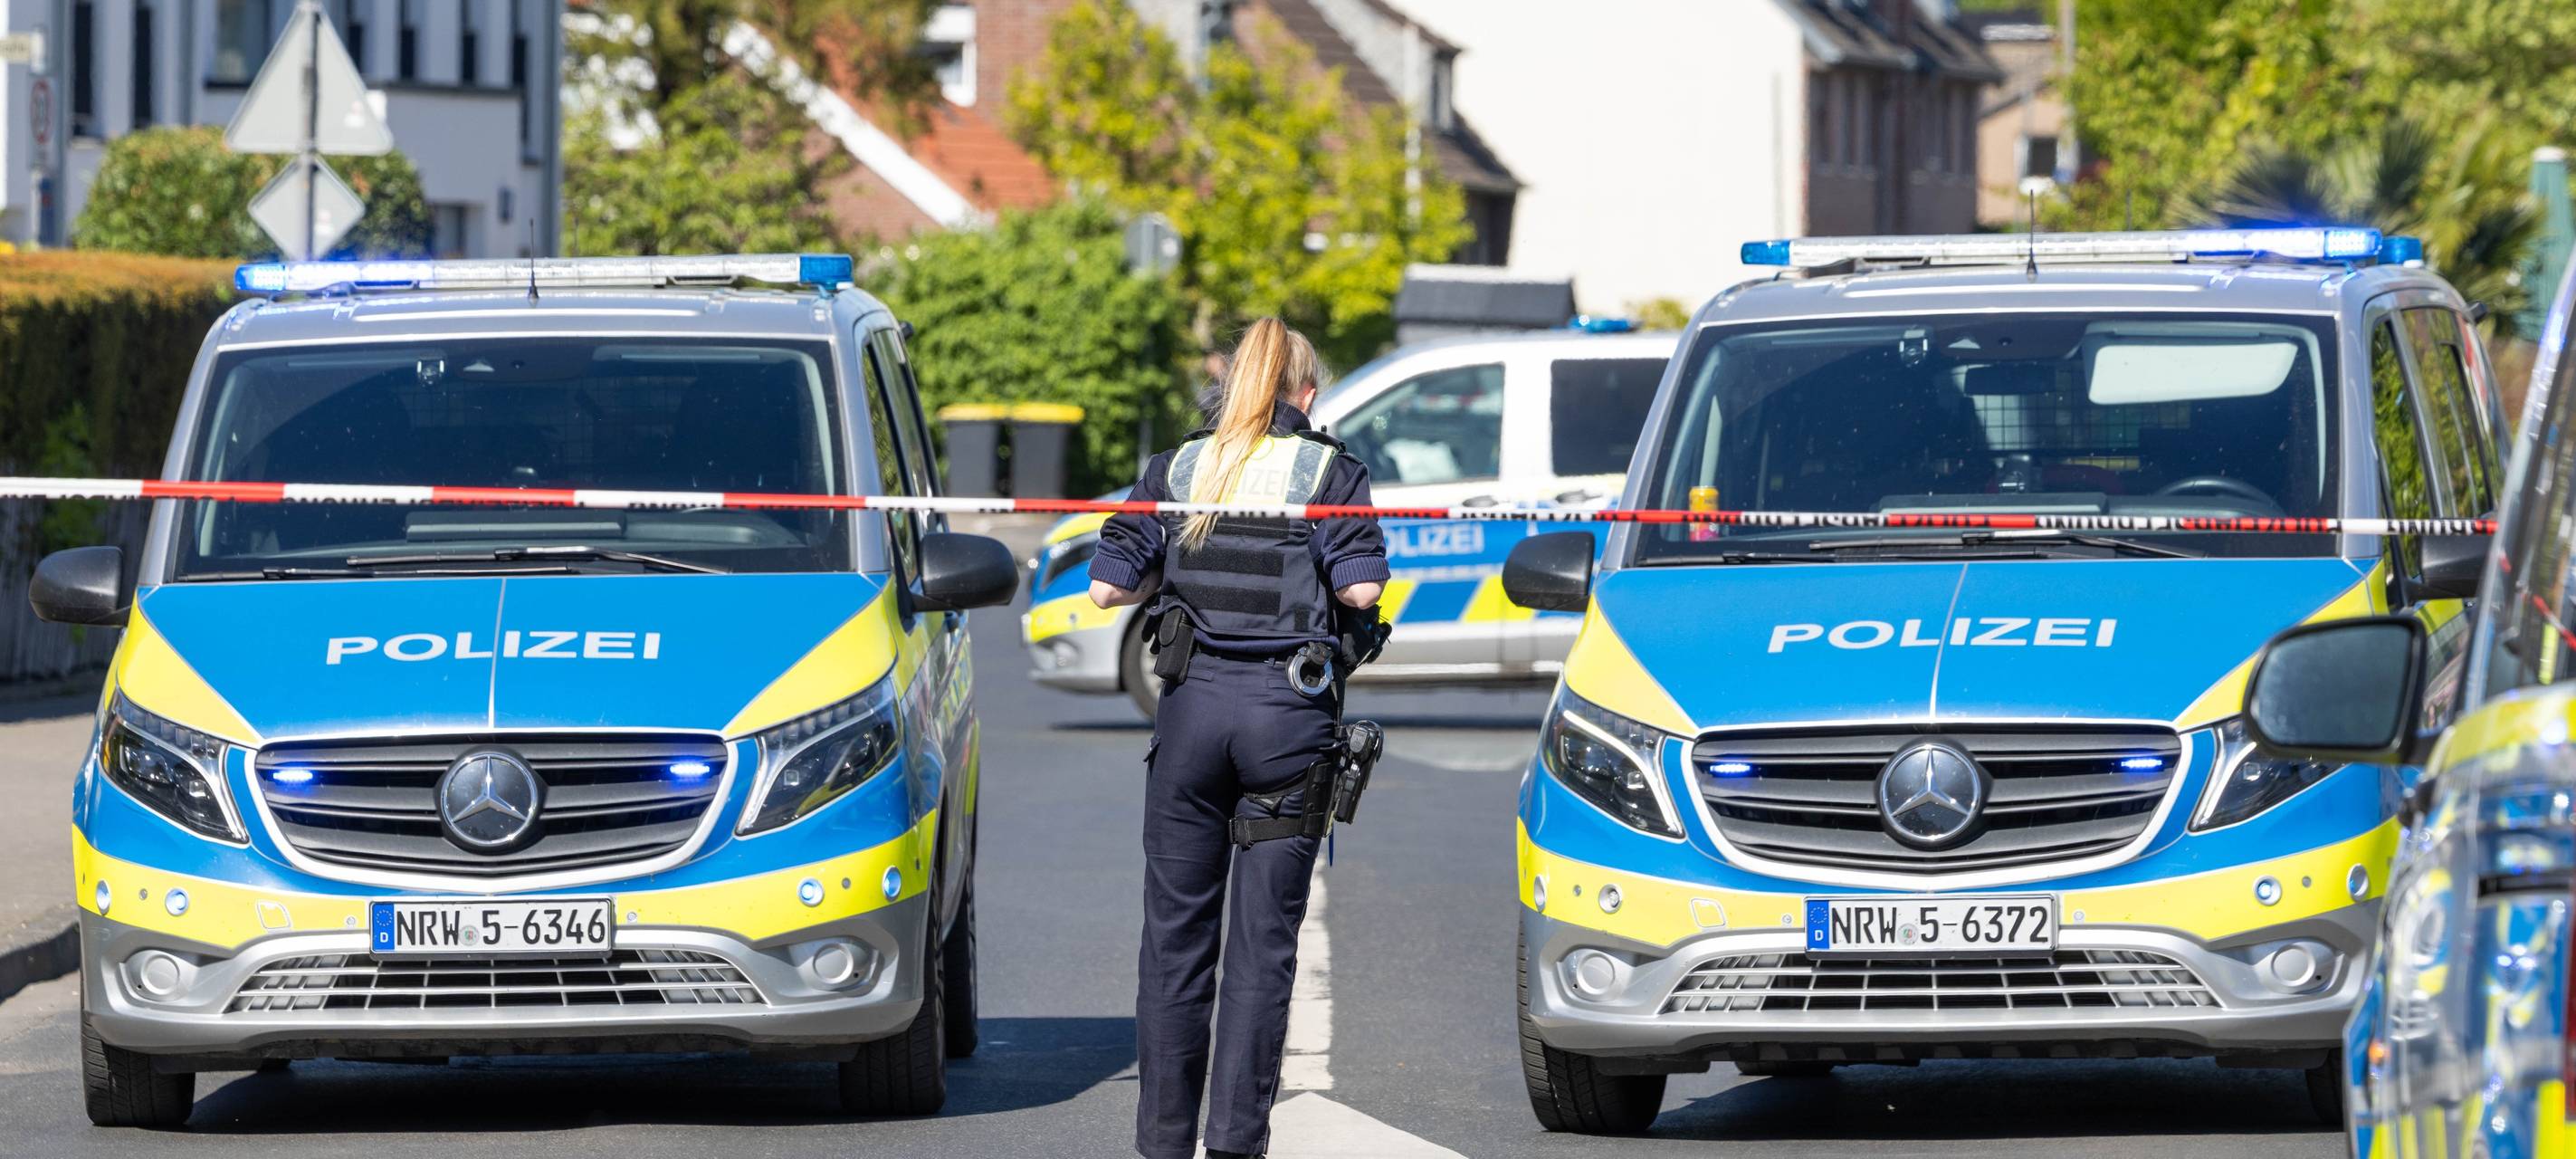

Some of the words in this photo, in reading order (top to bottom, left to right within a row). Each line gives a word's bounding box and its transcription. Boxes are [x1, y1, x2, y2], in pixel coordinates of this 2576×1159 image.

[1383, 523, 1484, 559] OLIZEI
[326, 630, 661, 666] POLIZEI
[1767, 618, 2118, 654] POLIZEI
[379, 933, 388, 943] D
[396, 910, 460, 946] NRW
[482, 908, 606, 945] 5-6346
[1815, 930, 1823, 942] D
[1831, 907, 1897, 944] NRW
[1920, 905, 2049, 943] 5-6372
